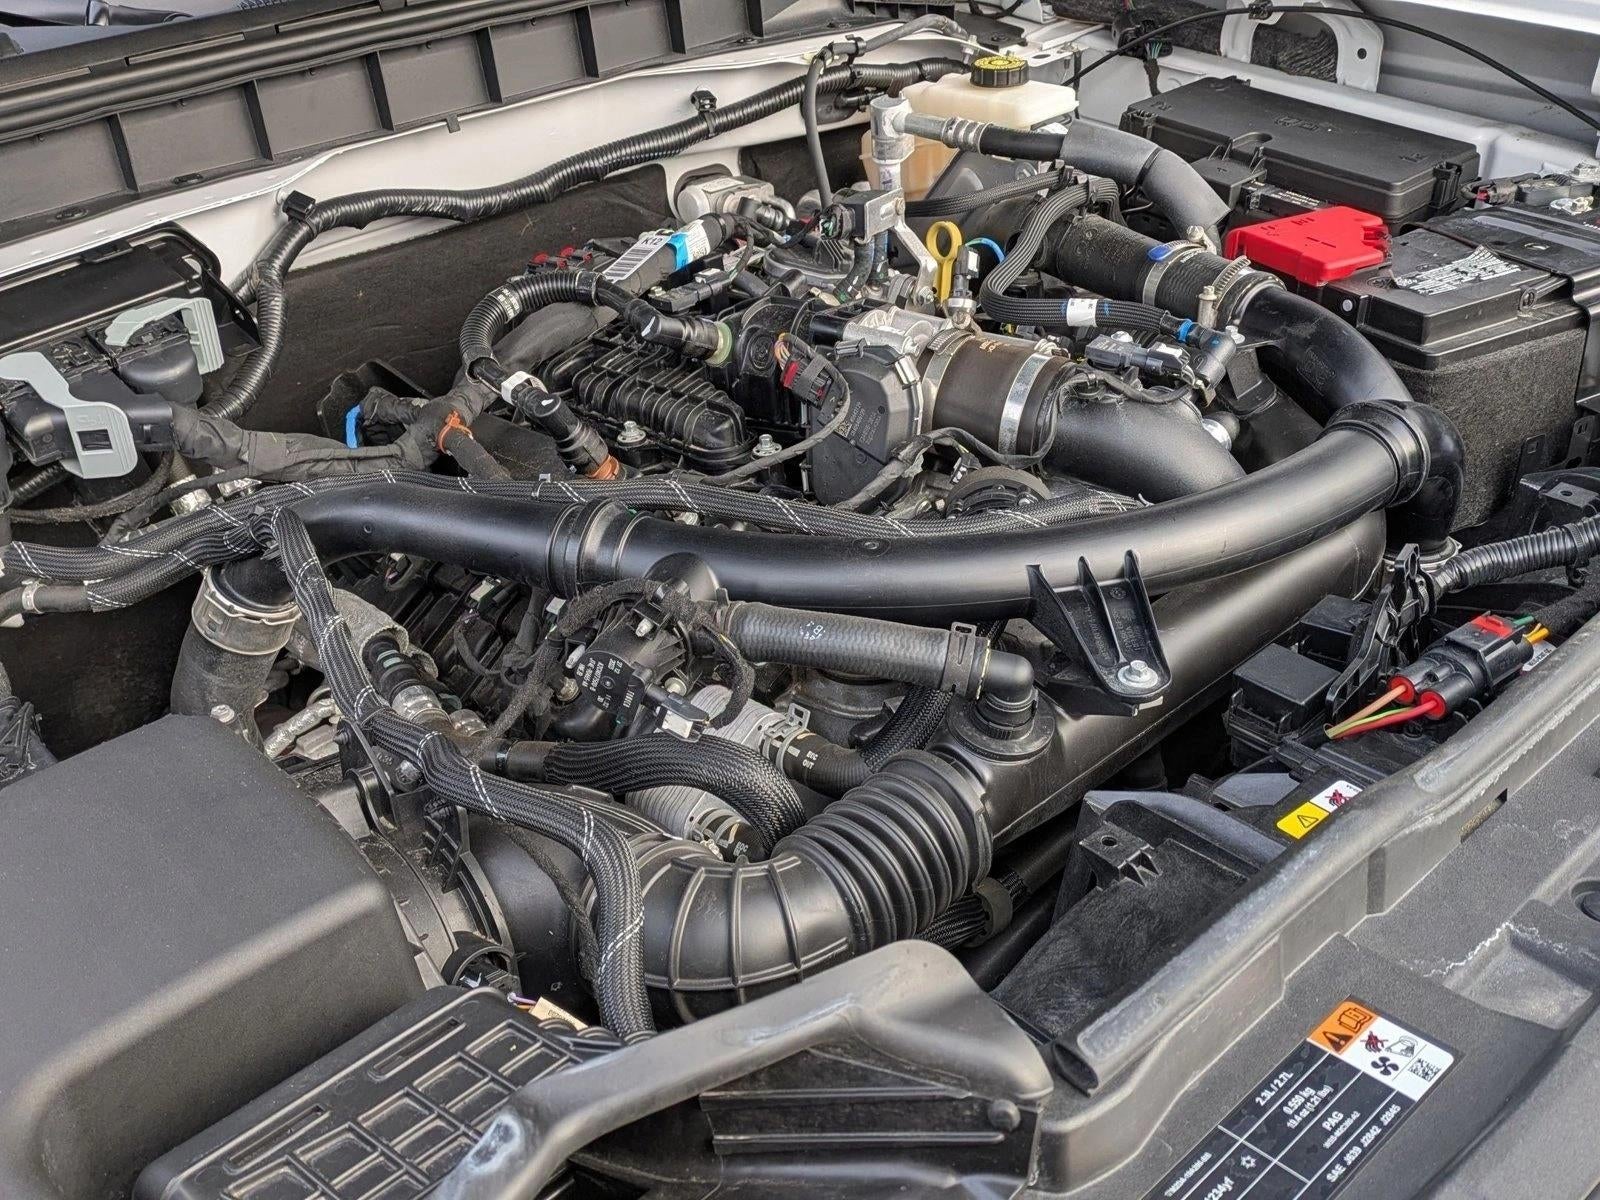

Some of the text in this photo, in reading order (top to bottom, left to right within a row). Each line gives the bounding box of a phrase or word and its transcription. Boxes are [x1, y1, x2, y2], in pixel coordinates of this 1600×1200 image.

[641, 237, 662, 245] K12
[802, 759, 815, 770] OUT
[1255, 1089, 1276, 1107] 2.3L
[1273, 1071, 1294, 1088] 2.7L
[1298, 1086, 1316, 1098] kg
[1321, 1111, 1344, 1131] PAG
[1326, 1163, 1347, 1182] SAE
